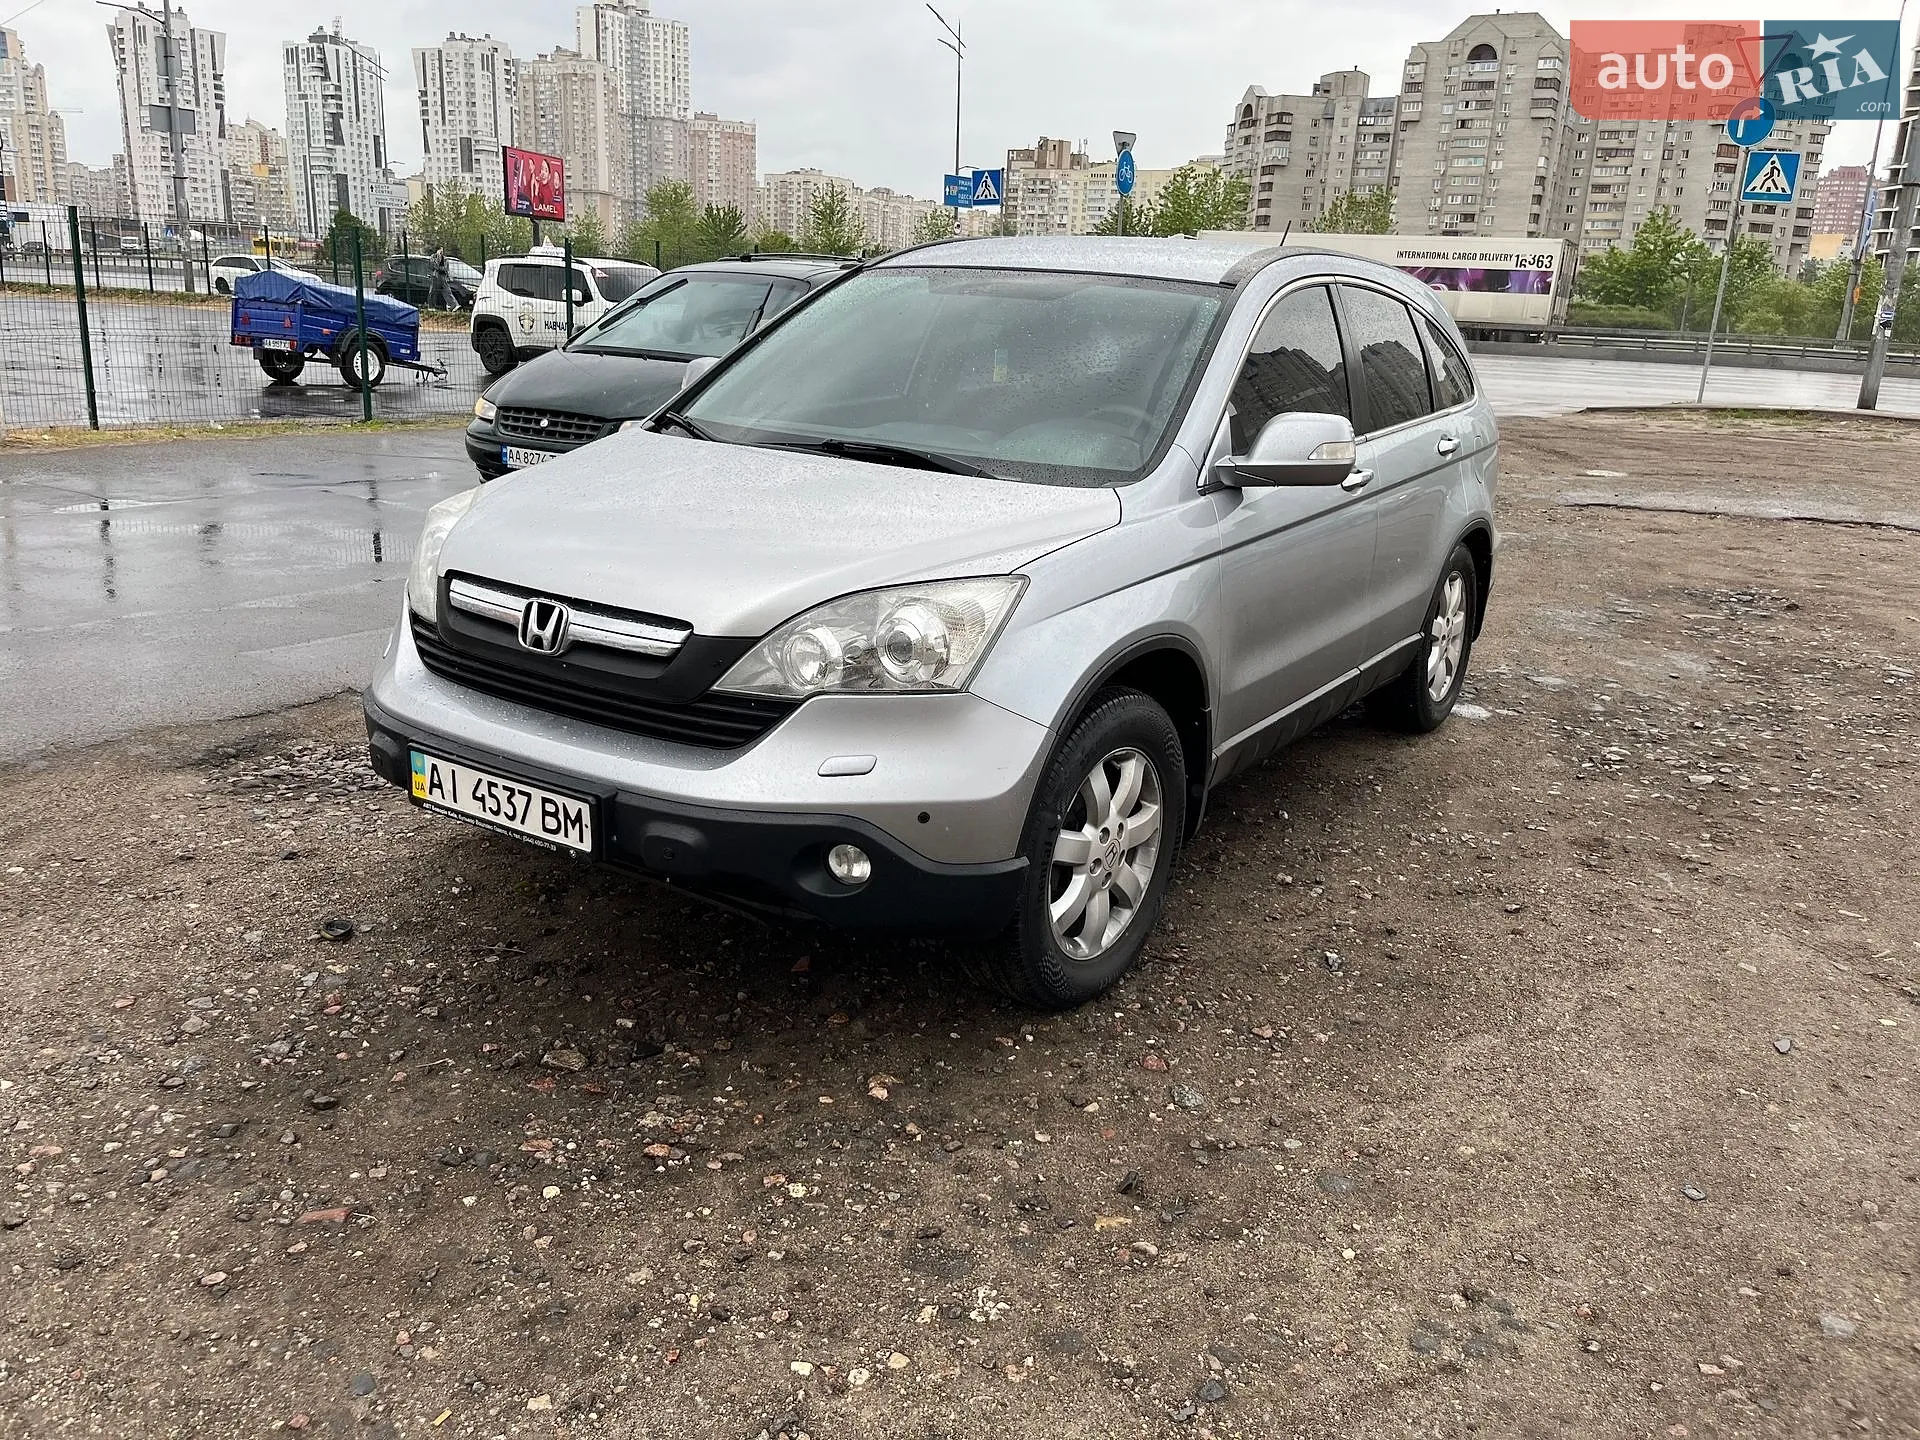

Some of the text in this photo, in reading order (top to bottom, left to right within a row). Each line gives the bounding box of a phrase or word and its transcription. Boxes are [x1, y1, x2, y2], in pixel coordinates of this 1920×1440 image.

[533, 203, 558, 214] LAMEL
[1396, 250, 1449, 260] INTERNATIONAL
[1452, 252, 1477, 261] CARGO
[1479, 253, 1513, 262] DELIVERY
[544, 320, 568, 331] НАВЧАЛ
[509, 449, 521, 463] AA
[414, 780, 426, 793] UA
[428, 762, 584, 844] AI 4537 BM
